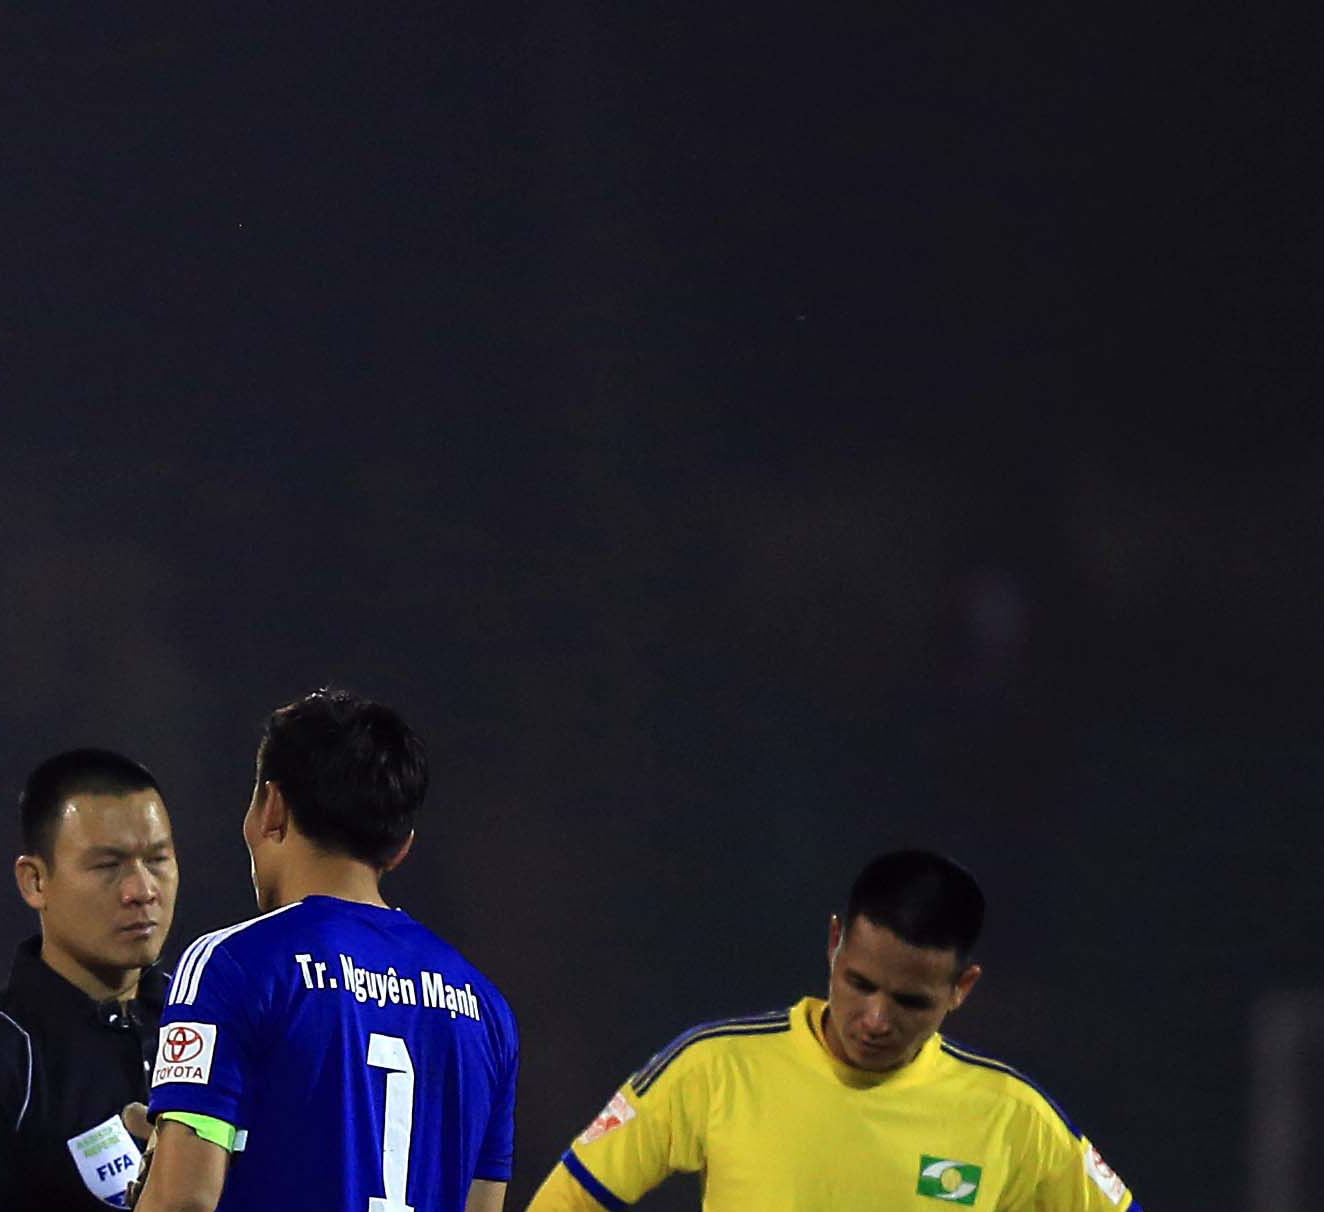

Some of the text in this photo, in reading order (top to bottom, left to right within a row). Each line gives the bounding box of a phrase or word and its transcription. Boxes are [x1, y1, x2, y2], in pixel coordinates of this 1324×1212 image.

[295, 953, 481, 1022] Tr. Nguyên Mạnh
[155, 1065, 204, 1083] TOYOTA
[95, 1153, 135, 1182] FIFA
